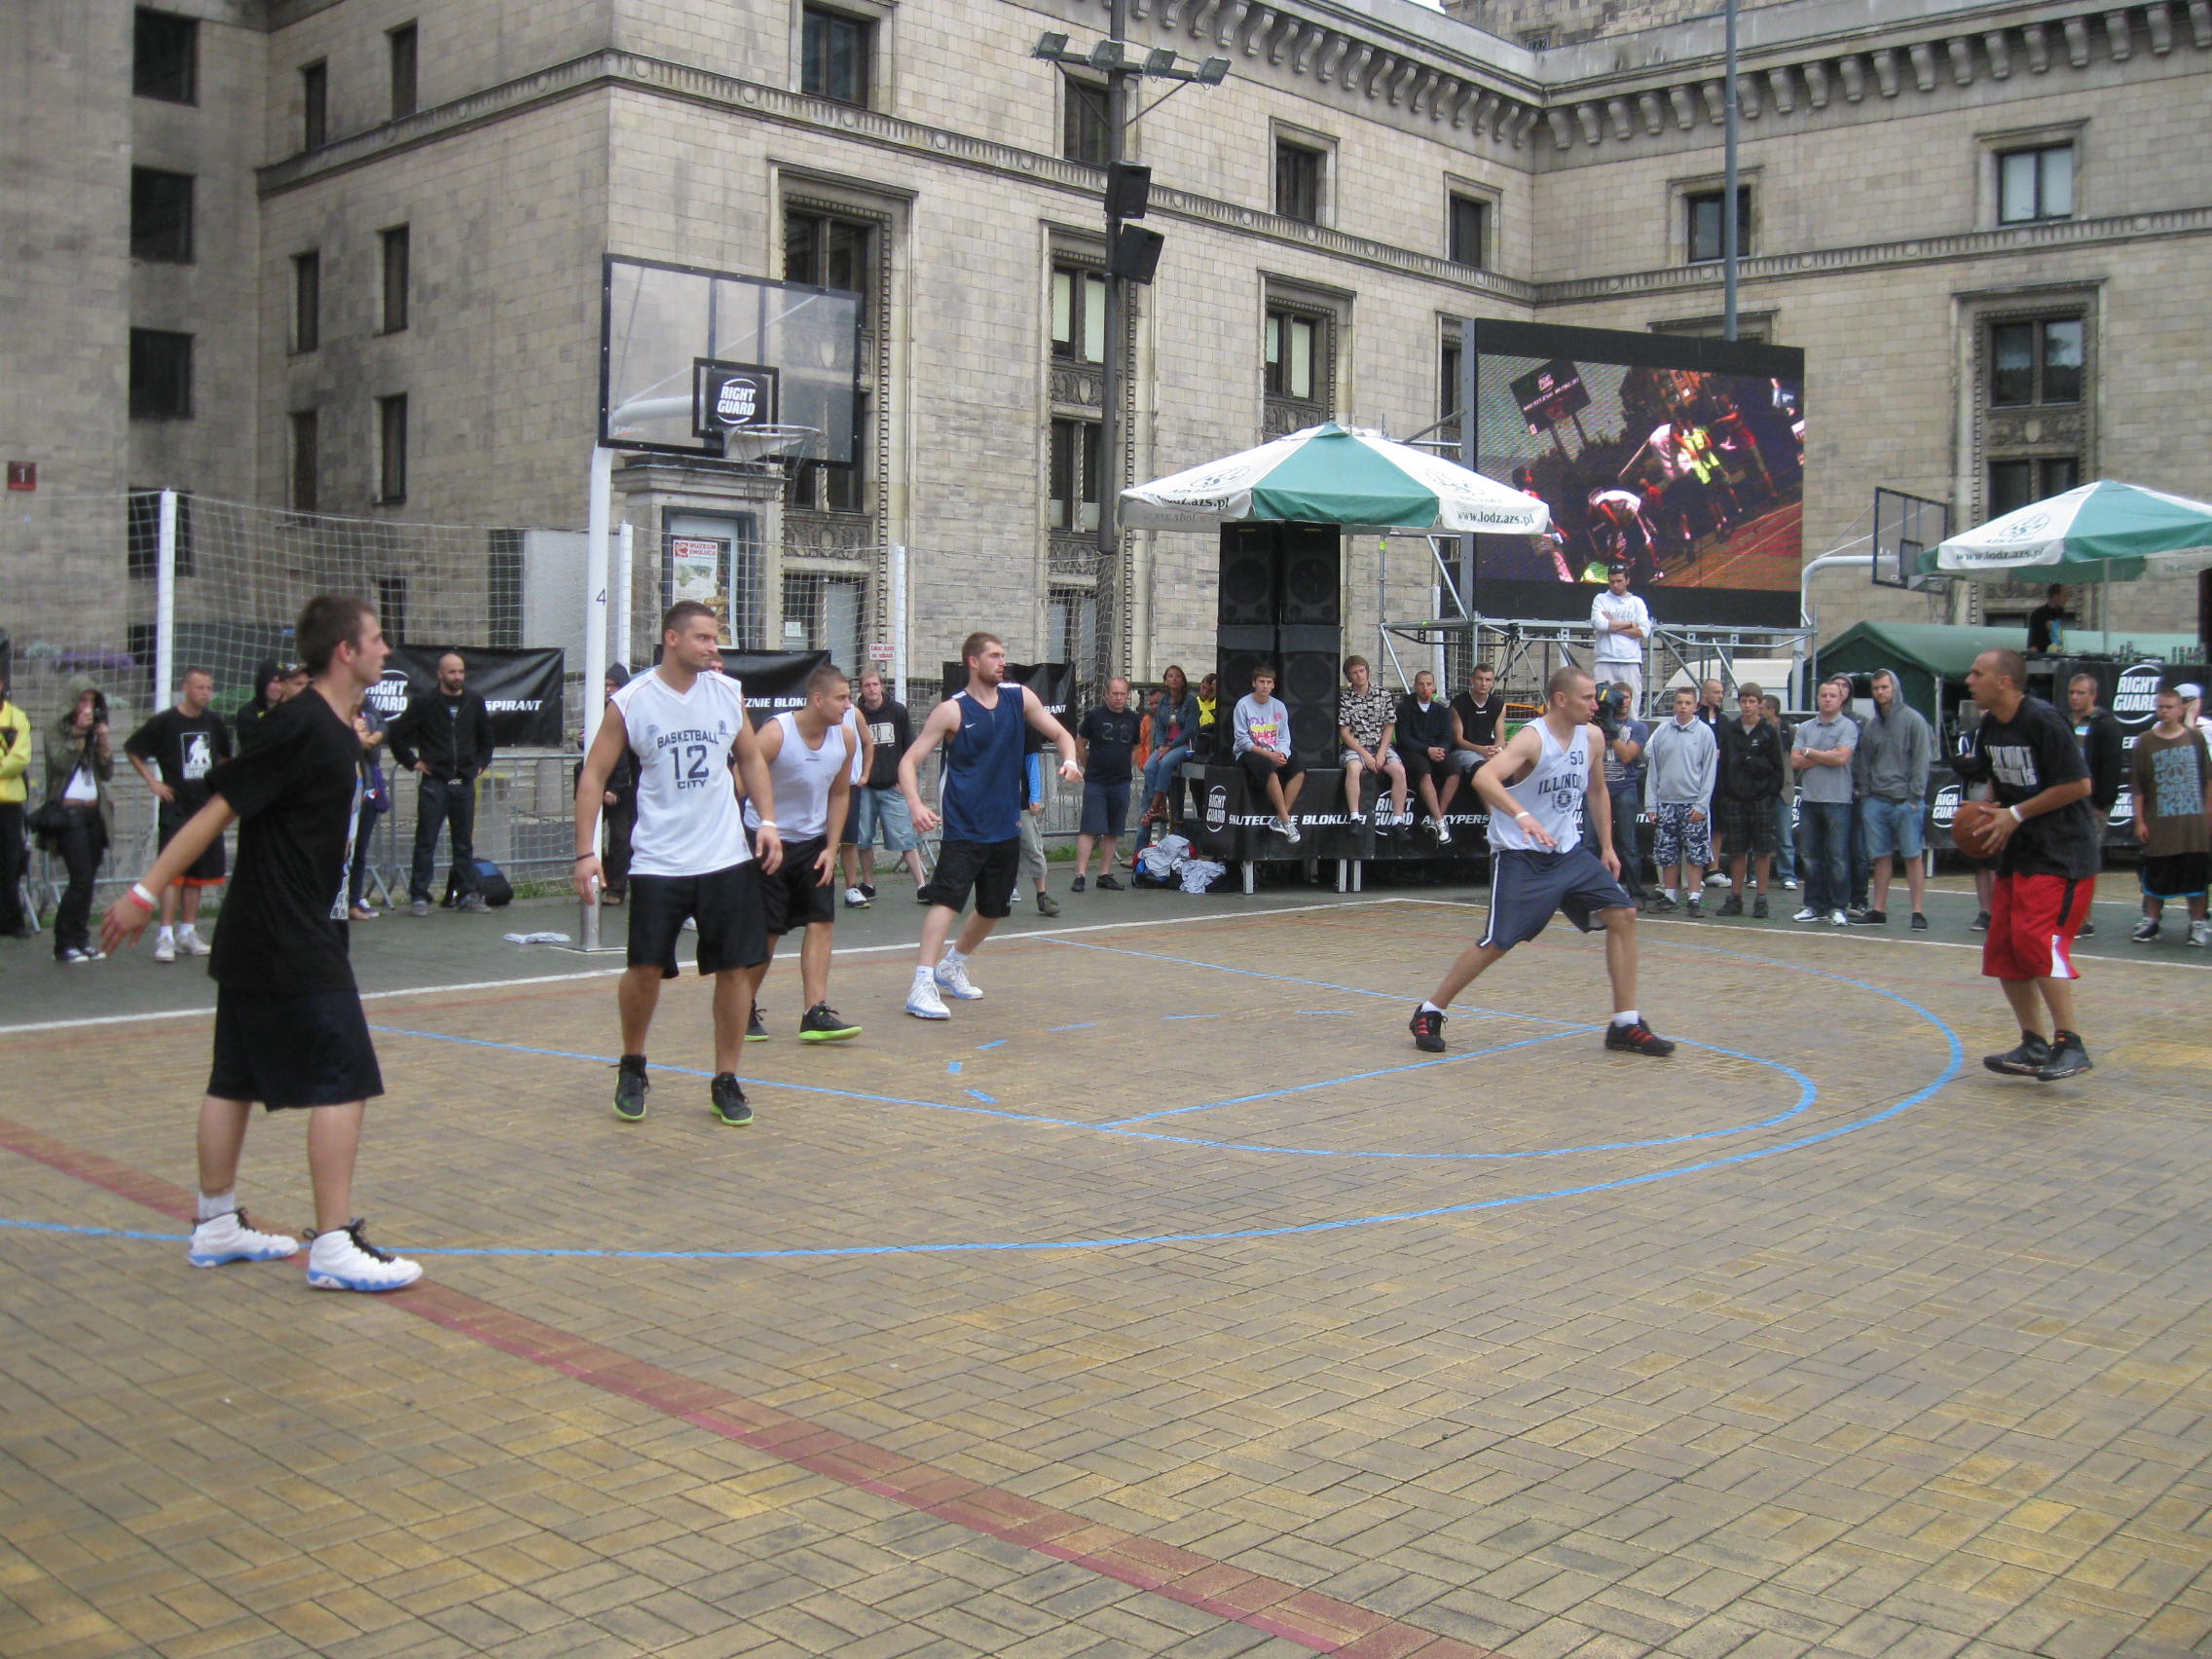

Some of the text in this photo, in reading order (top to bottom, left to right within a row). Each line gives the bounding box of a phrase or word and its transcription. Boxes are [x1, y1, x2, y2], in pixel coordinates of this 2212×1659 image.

[721, 386, 756, 402] RIGHT
[717, 399, 756, 417] GUARD
[1456, 511, 1535, 527] www.lodz.azs.pl
[596, 588, 607, 606] 4
[2117, 676, 2162, 693] RIGHT
[368, 695, 408, 712] UARD
[656, 729, 719, 749] BASKETBALL
[669, 744, 710, 781] 12
[1569, 750, 1584, 765] 50
[677, 779, 708, 790] CITY
[1208, 793, 1227, 809] RIGHT
[1206, 808, 1226, 824] GUARD
